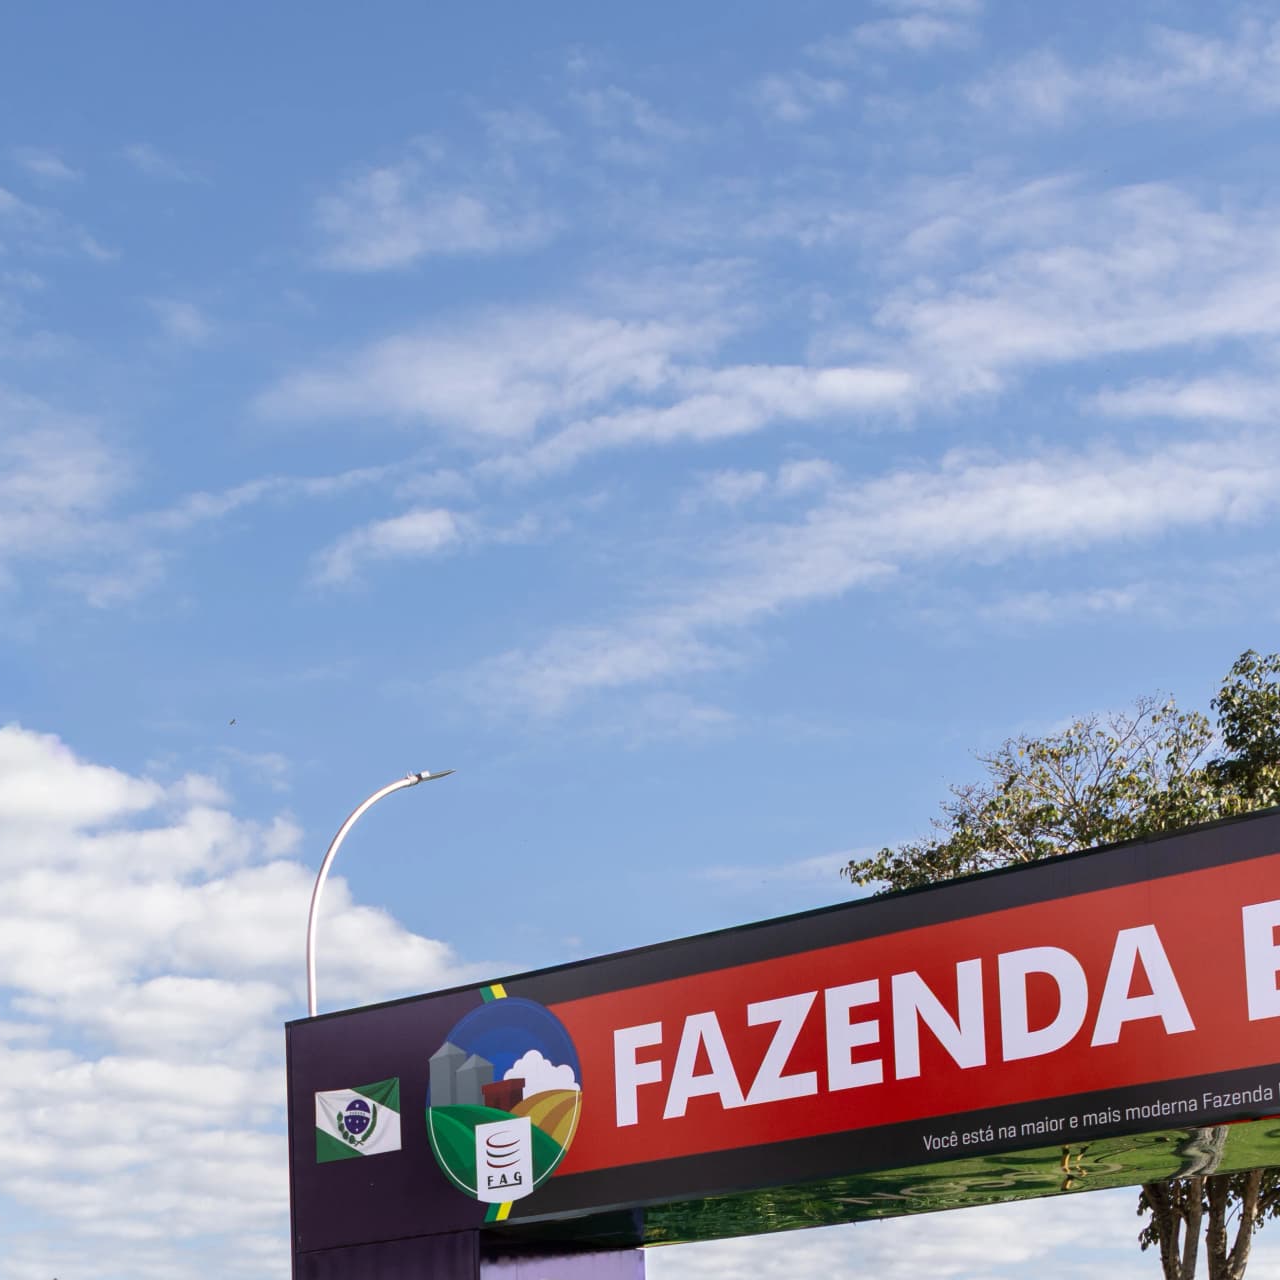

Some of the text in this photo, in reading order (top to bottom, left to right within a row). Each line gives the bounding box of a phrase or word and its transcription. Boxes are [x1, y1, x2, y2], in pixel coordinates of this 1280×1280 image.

[613, 924, 1197, 1128] FAZENDA
[923, 1131, 958, 1151] Você
[962, 1125, 994, 1145] está
[998, 1125, 1016, 1139] na
[1021, 1116, 1065, 1136] maior
[1070, 1115, 1079, 1128] e
[1083, 1103, 1121, 1126] mais
[1125, 1098, 1197, 1121] moderna
[1202, 1085, 1273, 1110] Fazenda
[487, 1171, 522, 1188] FAG
